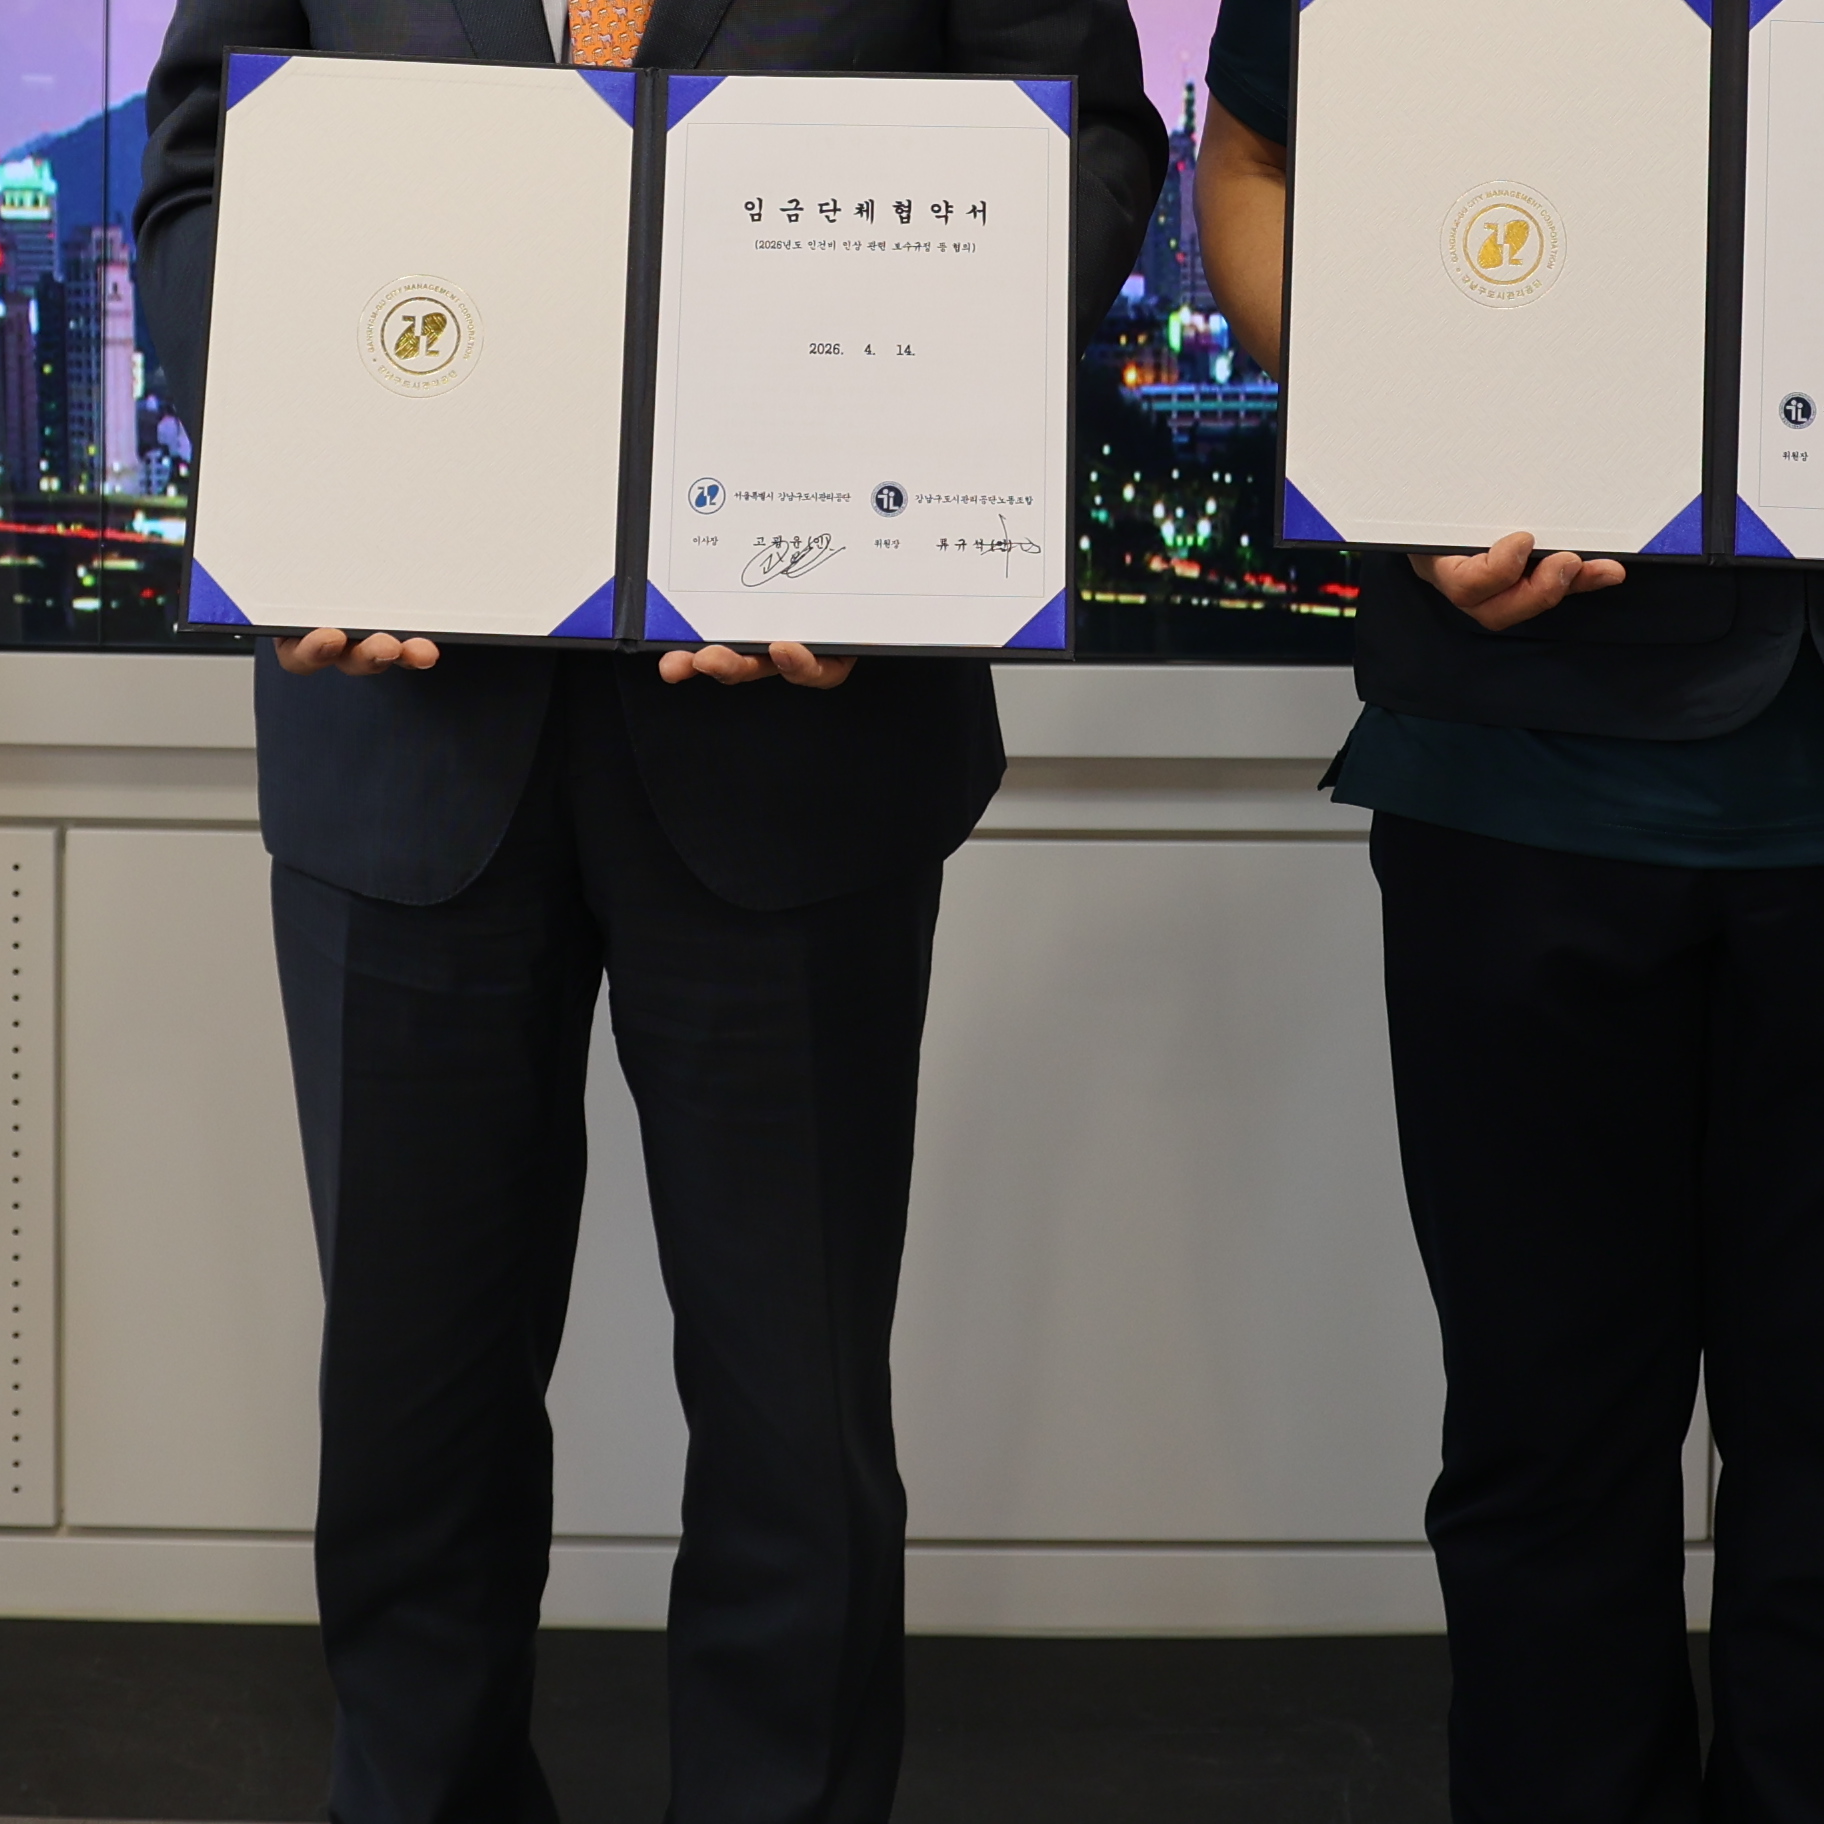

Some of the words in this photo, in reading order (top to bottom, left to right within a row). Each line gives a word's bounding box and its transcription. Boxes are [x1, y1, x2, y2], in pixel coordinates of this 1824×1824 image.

[754, 240, 803, 251] (2026년도
[808, 240, 836, 251] 인건비
[842, 240, 862, 251] 인상
[809, 343, 844, 355] 2026.
[864, 343, 876, 355] 4.
[896, 344, 916, 356] 14.
